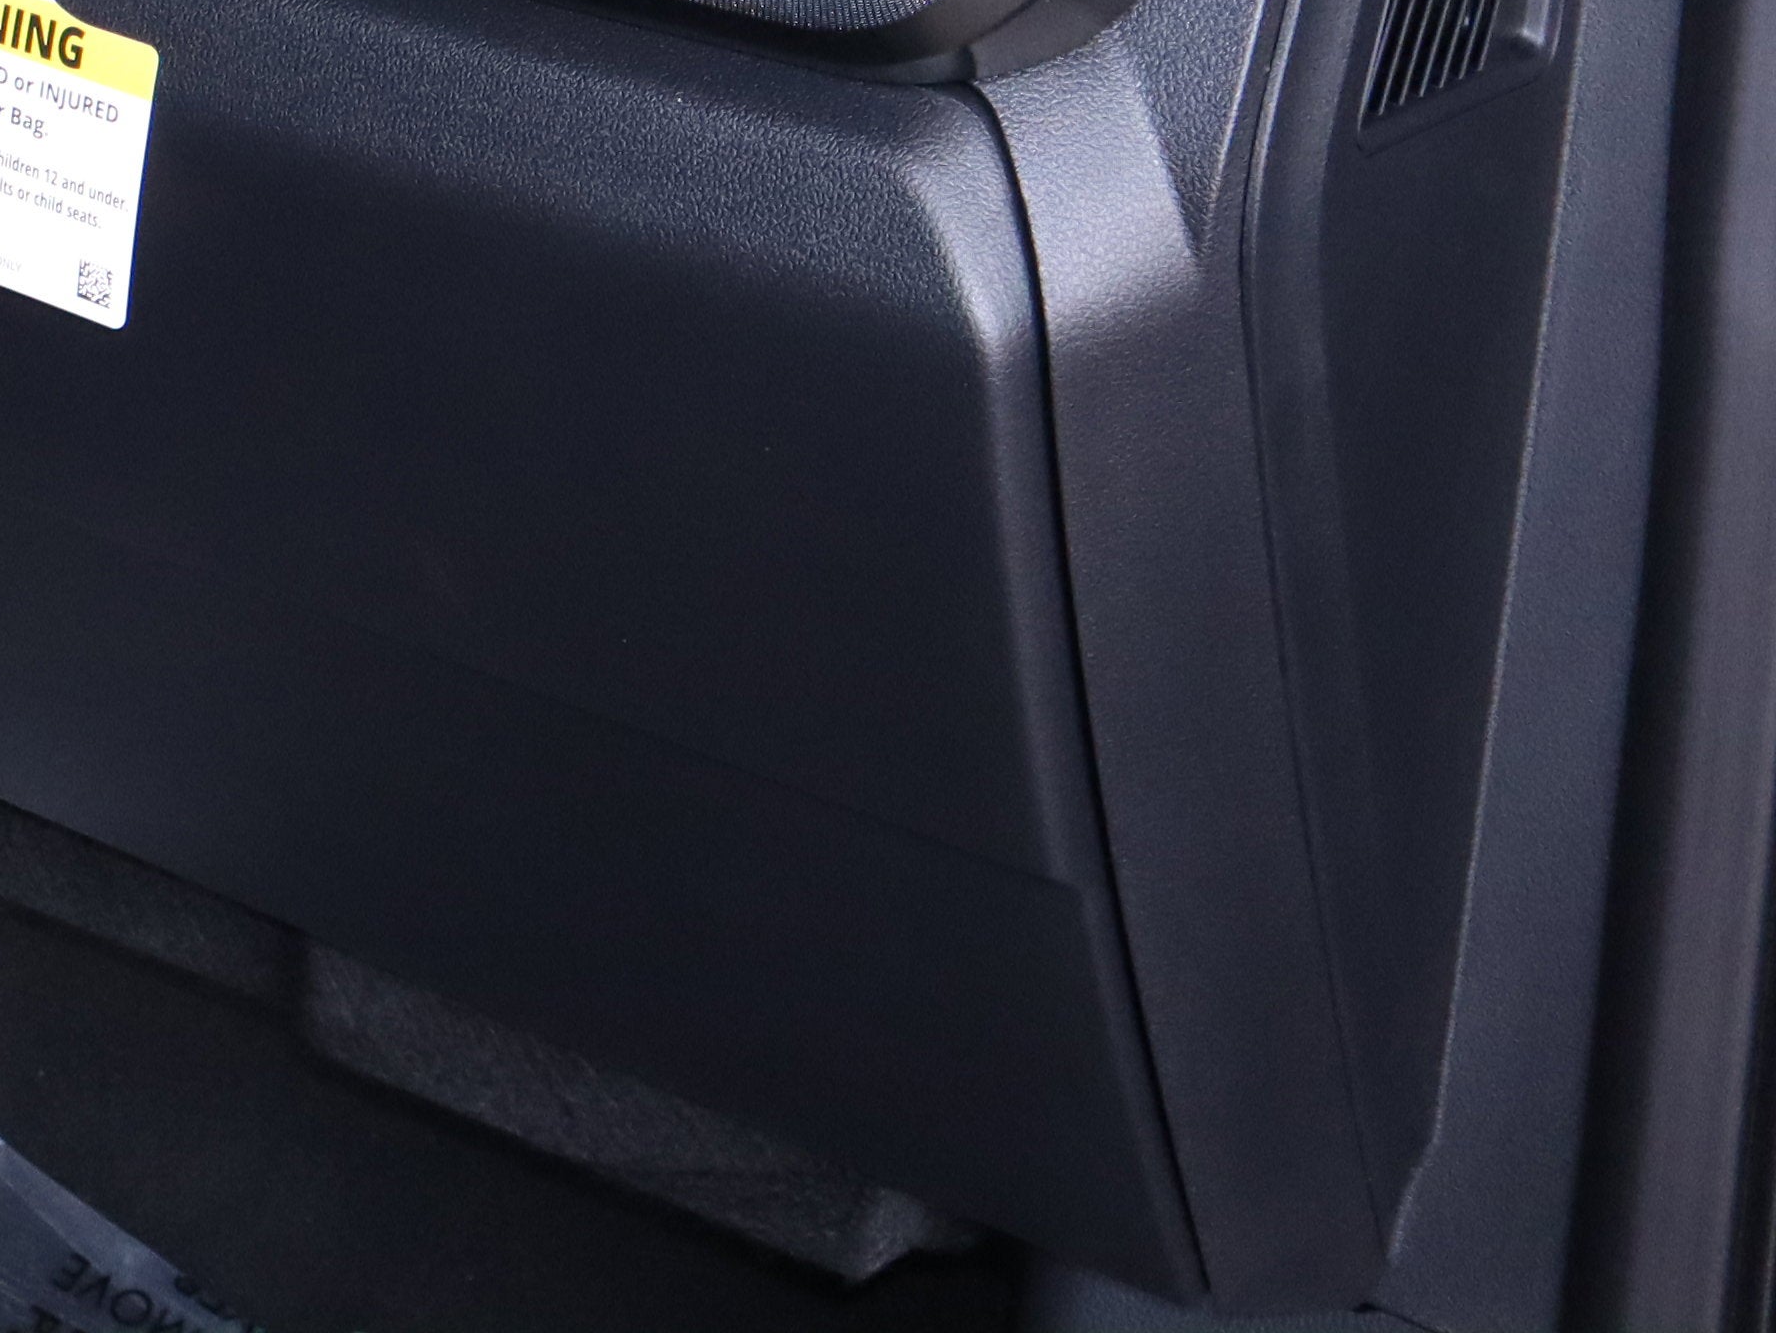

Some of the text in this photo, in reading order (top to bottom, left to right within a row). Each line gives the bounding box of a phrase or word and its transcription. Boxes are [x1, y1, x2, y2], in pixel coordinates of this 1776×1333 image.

[14, 76, 35, 94] or
[39, 81, 119, 123] INJURED
[10, 106, 48, 139] Bag.
[17, 187, 31, 203] or
[33, 192, 64, 214] child
[66, 204, 102, 229] seats.
[44, 168, 58, 186] 12
[61, 177, 85, 196] and
[88, 186, 129, 213] under.
